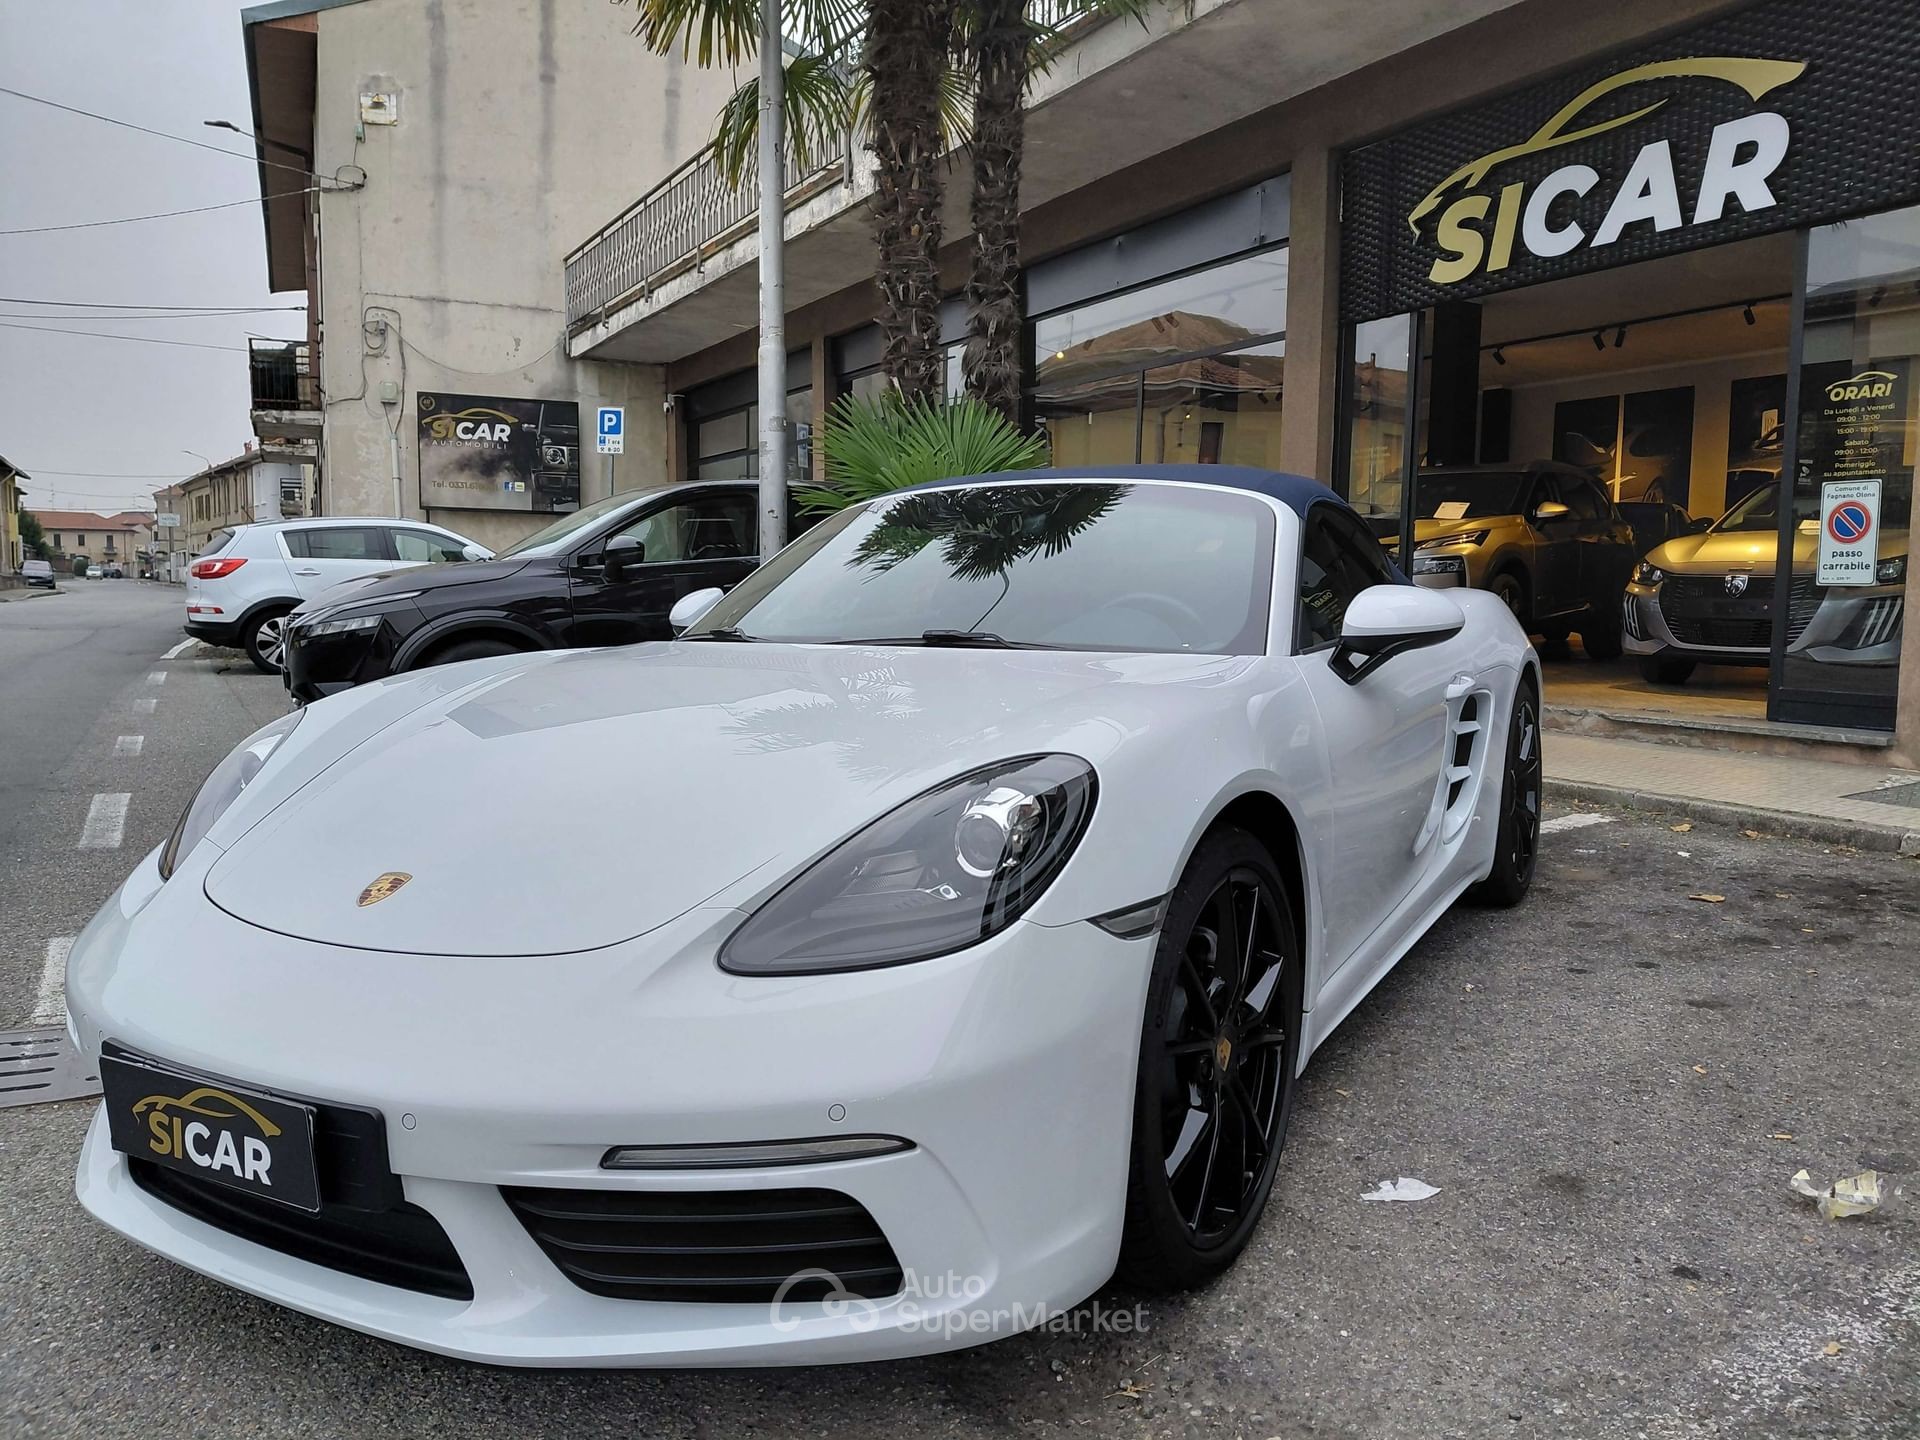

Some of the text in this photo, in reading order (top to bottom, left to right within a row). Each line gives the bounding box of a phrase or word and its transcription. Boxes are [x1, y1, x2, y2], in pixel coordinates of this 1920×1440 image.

[1428, 112, 1790, 284] SICAR
[1830, 382, 1893, 402] ORARI
[604, 413, 617, 432] P
[1836, 415, 1857, 423] 09:00
[1862, 413, 1881, 421] 12:00
[431, 419, 511, 442] SICAR
[1837, 427, 1855, 435] 15:00
[432, 440, 507, 450] AUTOMOBILI
[1834, 460, 1876, 469] Pomeriggio
[1833, 468, 1887, 477] appuntamento
[1826, 492, 1855, 500] Fagnano
[1831, 550, 1863, 559] passo
[1822, 560, 1871, 570] carrabile
[148, 1111, 272, 1186] SICAR
